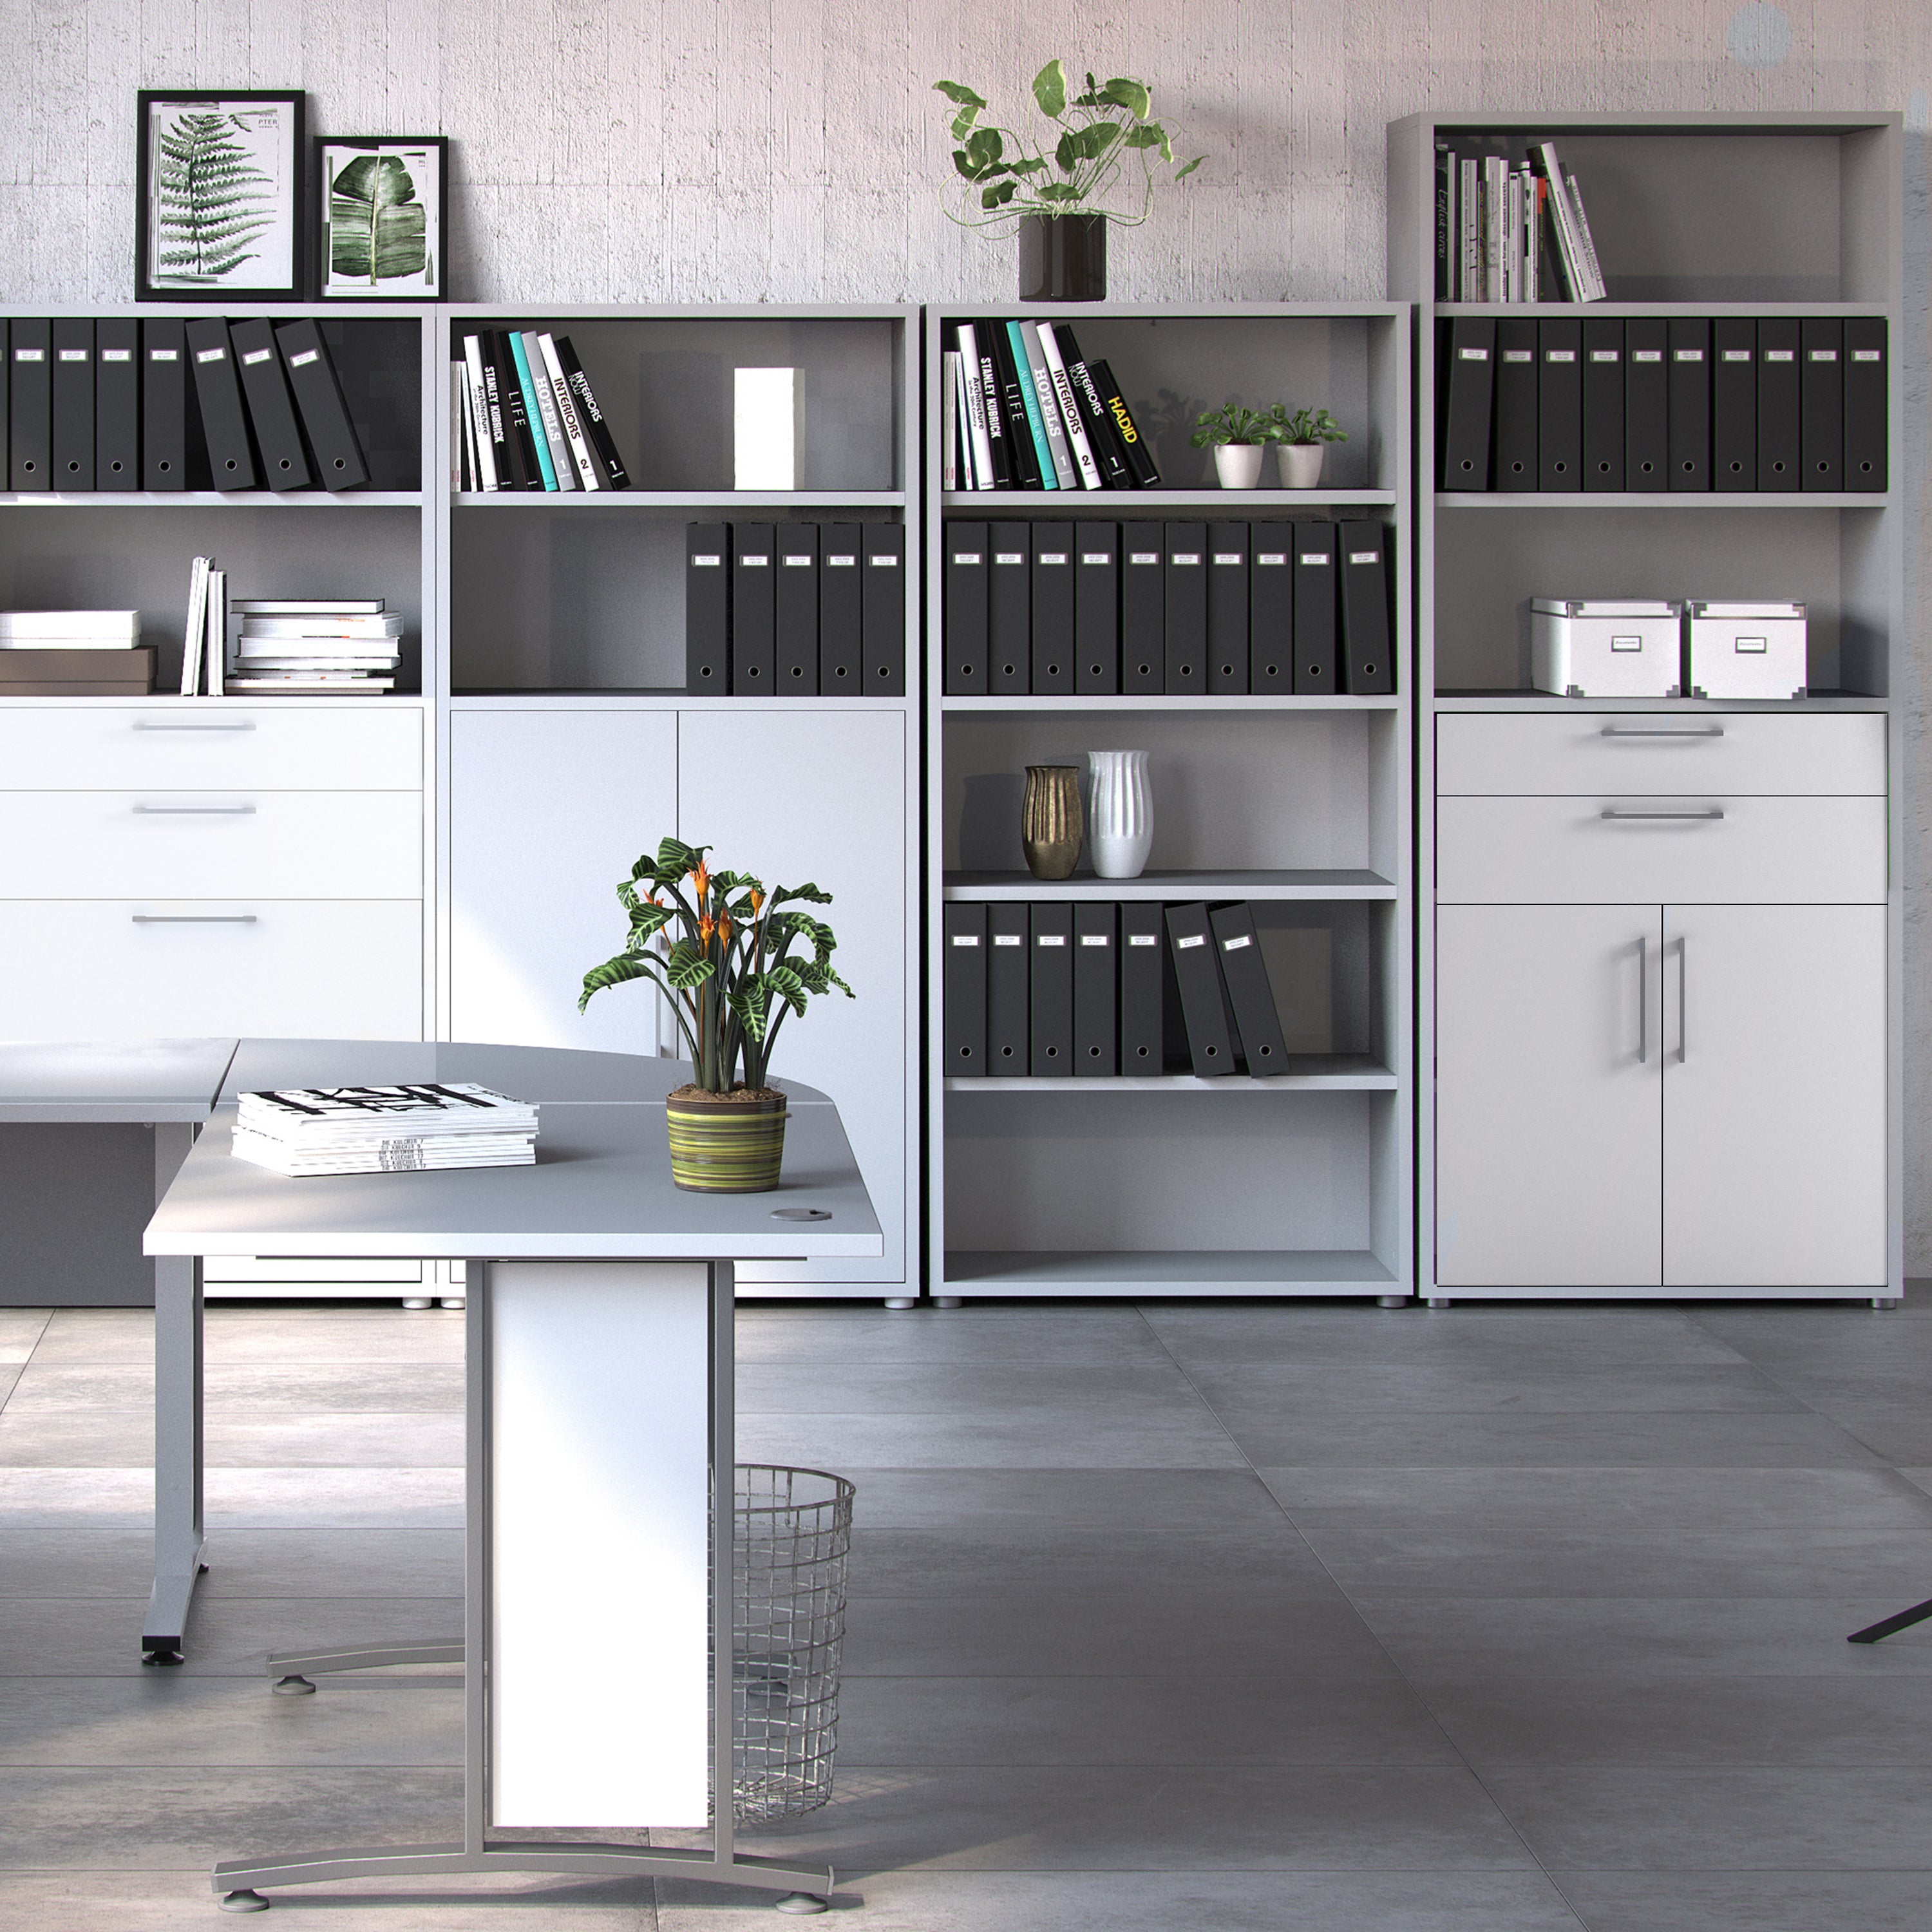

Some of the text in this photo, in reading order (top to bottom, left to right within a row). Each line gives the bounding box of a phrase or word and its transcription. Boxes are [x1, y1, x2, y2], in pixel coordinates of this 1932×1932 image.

[477, 385, 488, 435] Architecture
[484, 366, 504, 443] STANLEY KUBRICK
[508, 391, 526, 427] LIFE
[522, 377, 544, 447] AUDREY HEPBURN
[535, 375, 566, 470] HOTELS 1
[554, 377, 589, 469] INTERIORS 2
[574, 371, 618, 471] INTERIORS 1
[972, 377, 984, 430] Architecture
[980, 357, 1001, 439] STANLEY KUBRICK
[1006, 383, 1024, 421] LIFE
[1020, 369, 1043, 442] AUDREY HEPBURN
[1034, 367, 1066, 466] HOTELS 1
[1054, 369, 1091, 466] INTERIORS 2
[1075, 361, 1118, 468] INTERIORS 1
[1108, 396, 1137, 443] HADID
